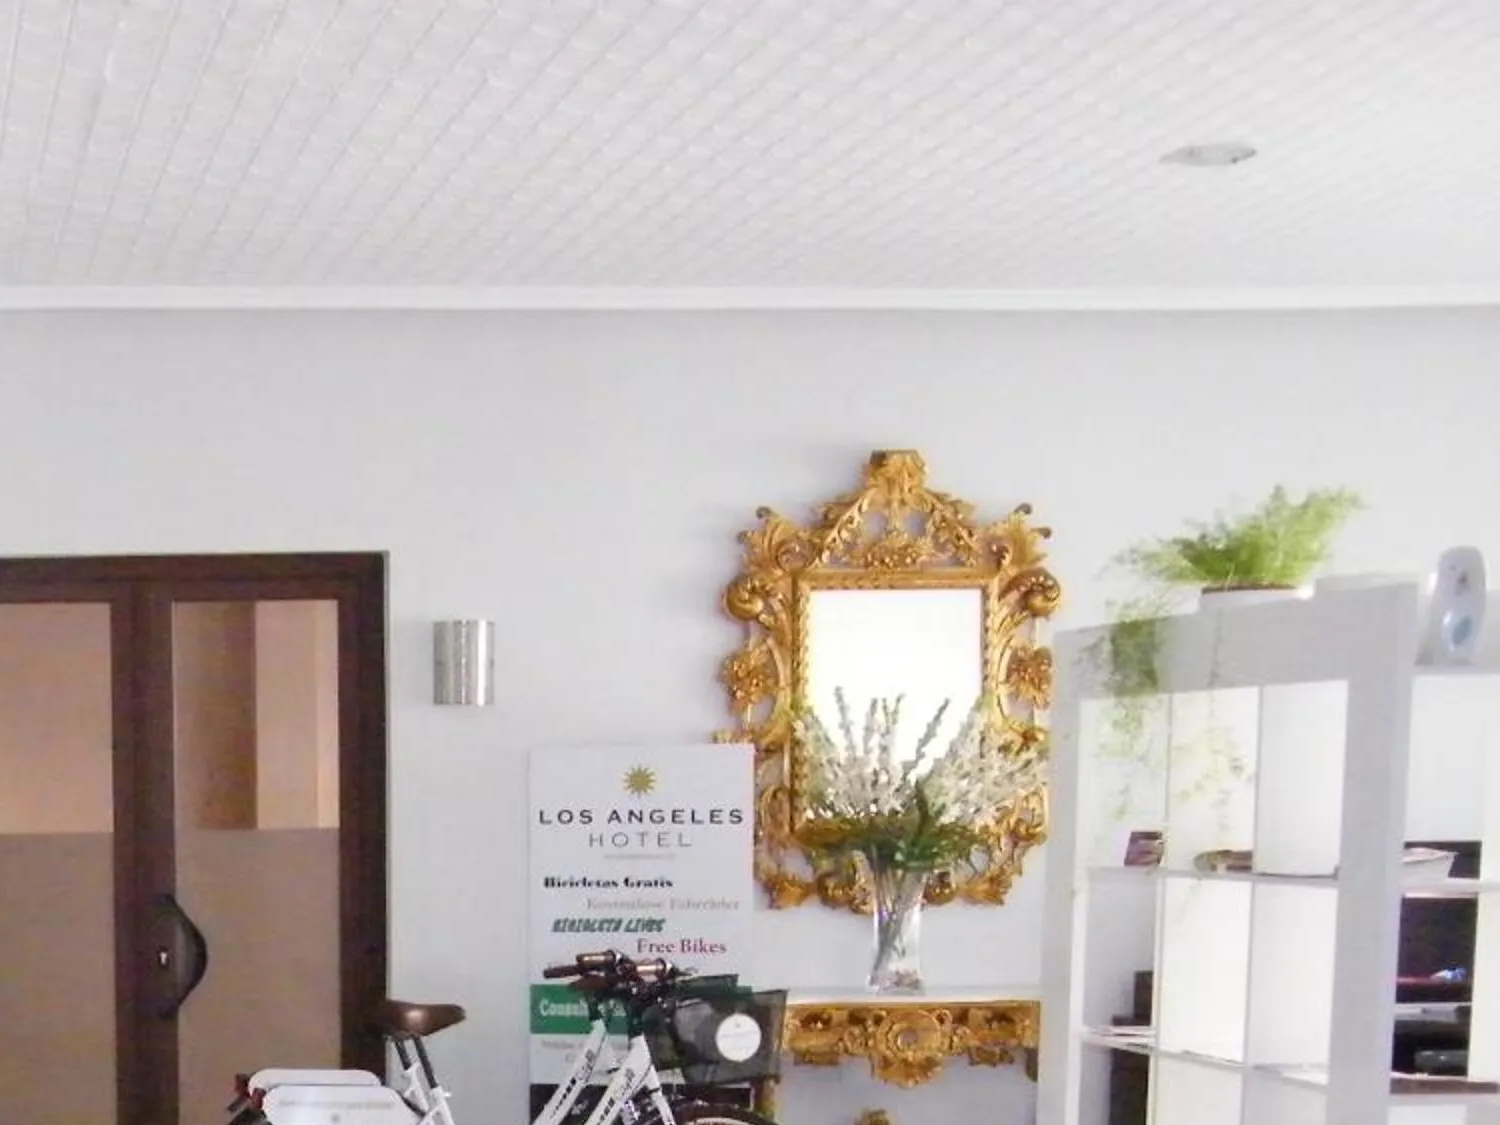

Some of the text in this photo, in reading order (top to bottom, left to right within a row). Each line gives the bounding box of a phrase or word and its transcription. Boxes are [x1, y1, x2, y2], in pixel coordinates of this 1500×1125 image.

[538, 808, 744, 825] LOS ANGELES
[588, 832, 693, 848] HOTEL
[543, 875, 674, 889] Bicicletas Gratis
[636, 938, 728, 954] Free Bikes
